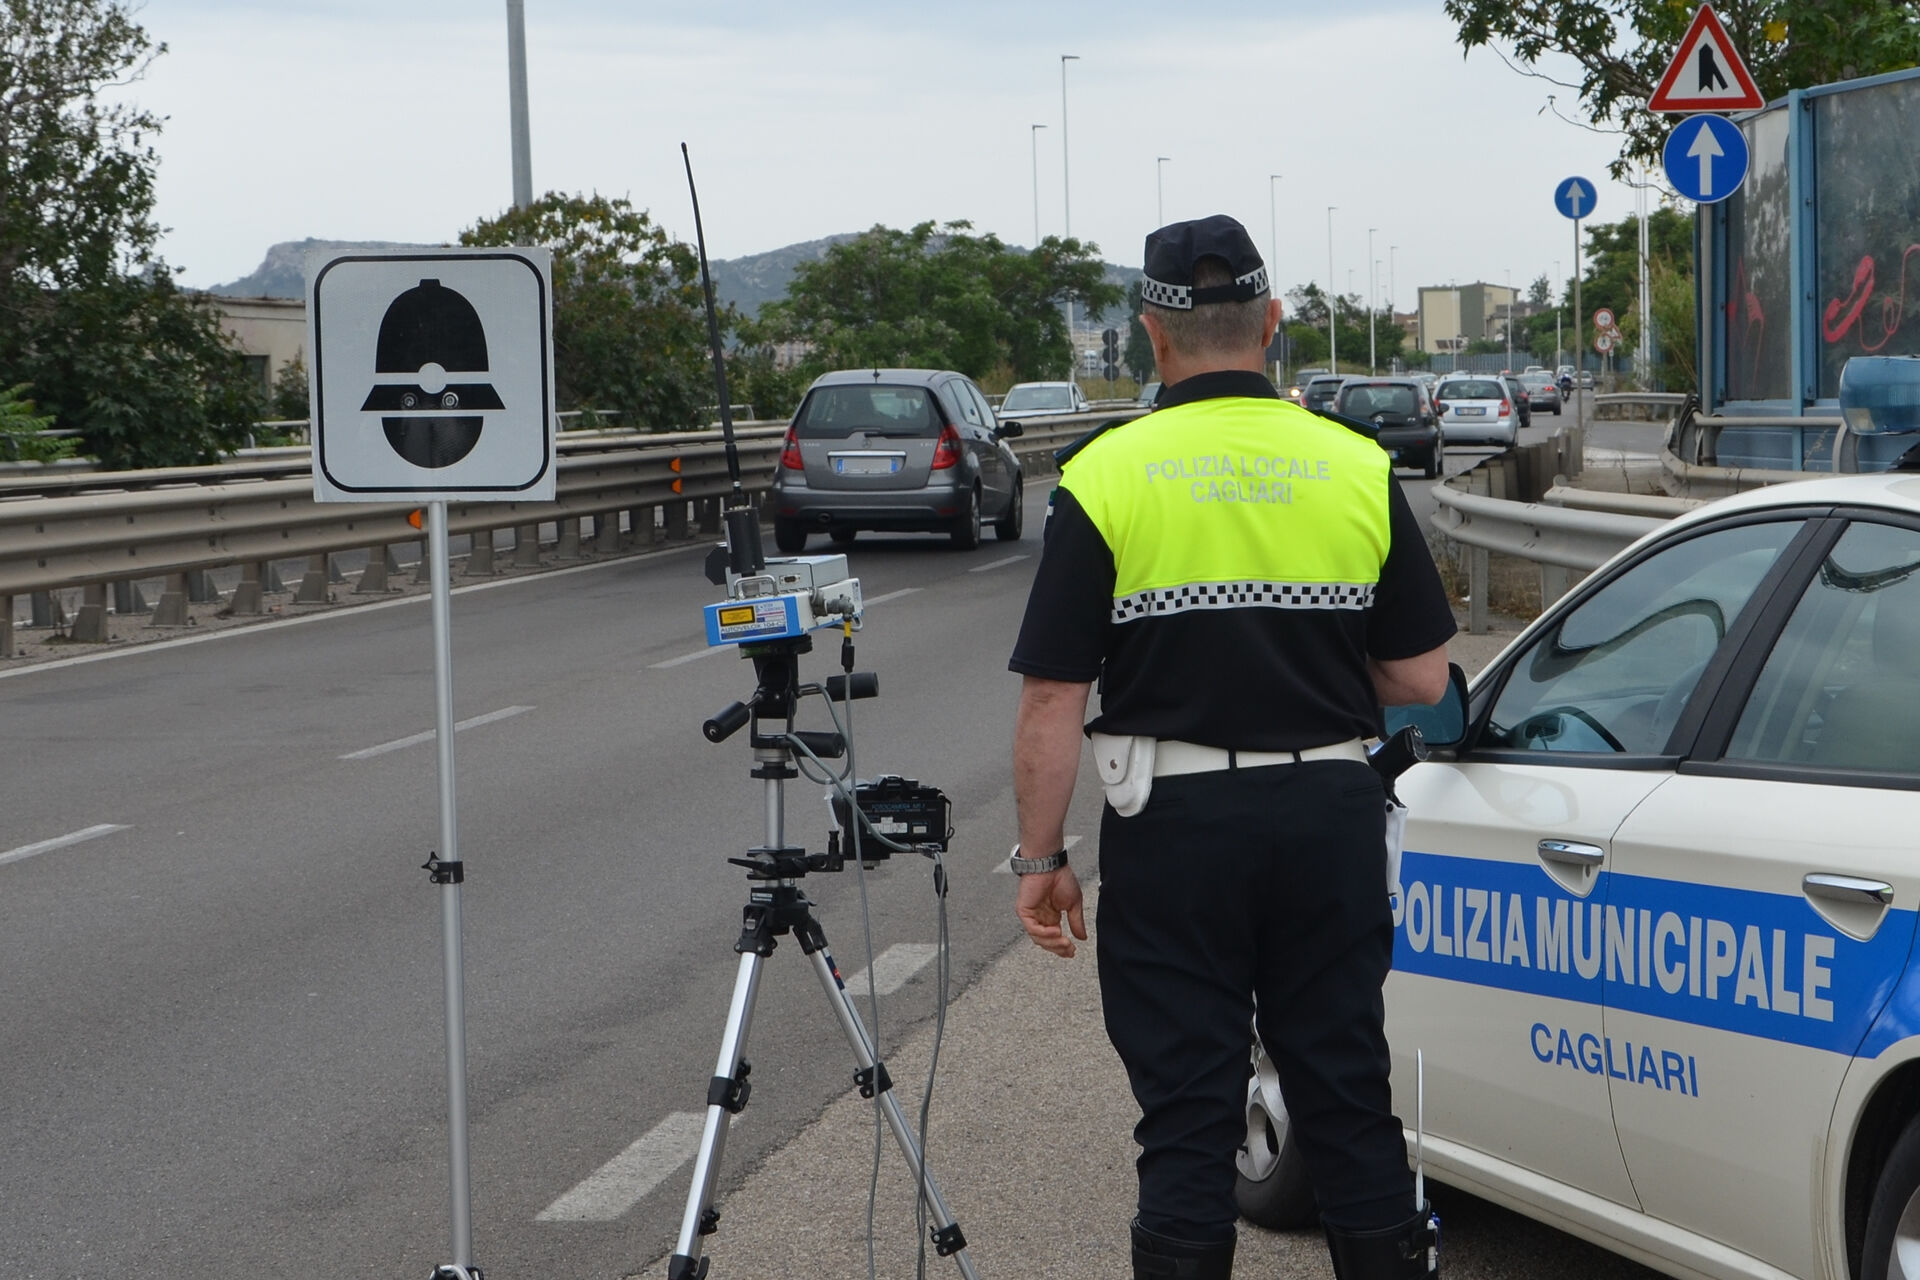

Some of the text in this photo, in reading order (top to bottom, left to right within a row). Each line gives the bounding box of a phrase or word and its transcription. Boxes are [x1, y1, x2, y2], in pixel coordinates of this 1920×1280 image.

[1145, 455, 1331, 484] POLIZIA LOCALE
[1190, 480, 1292, 504] CAGLIARI
[1536, 897, 1836, 1022] MUNICIPALE
[1530, 1023, 1699, 1098] CAGLIARI
